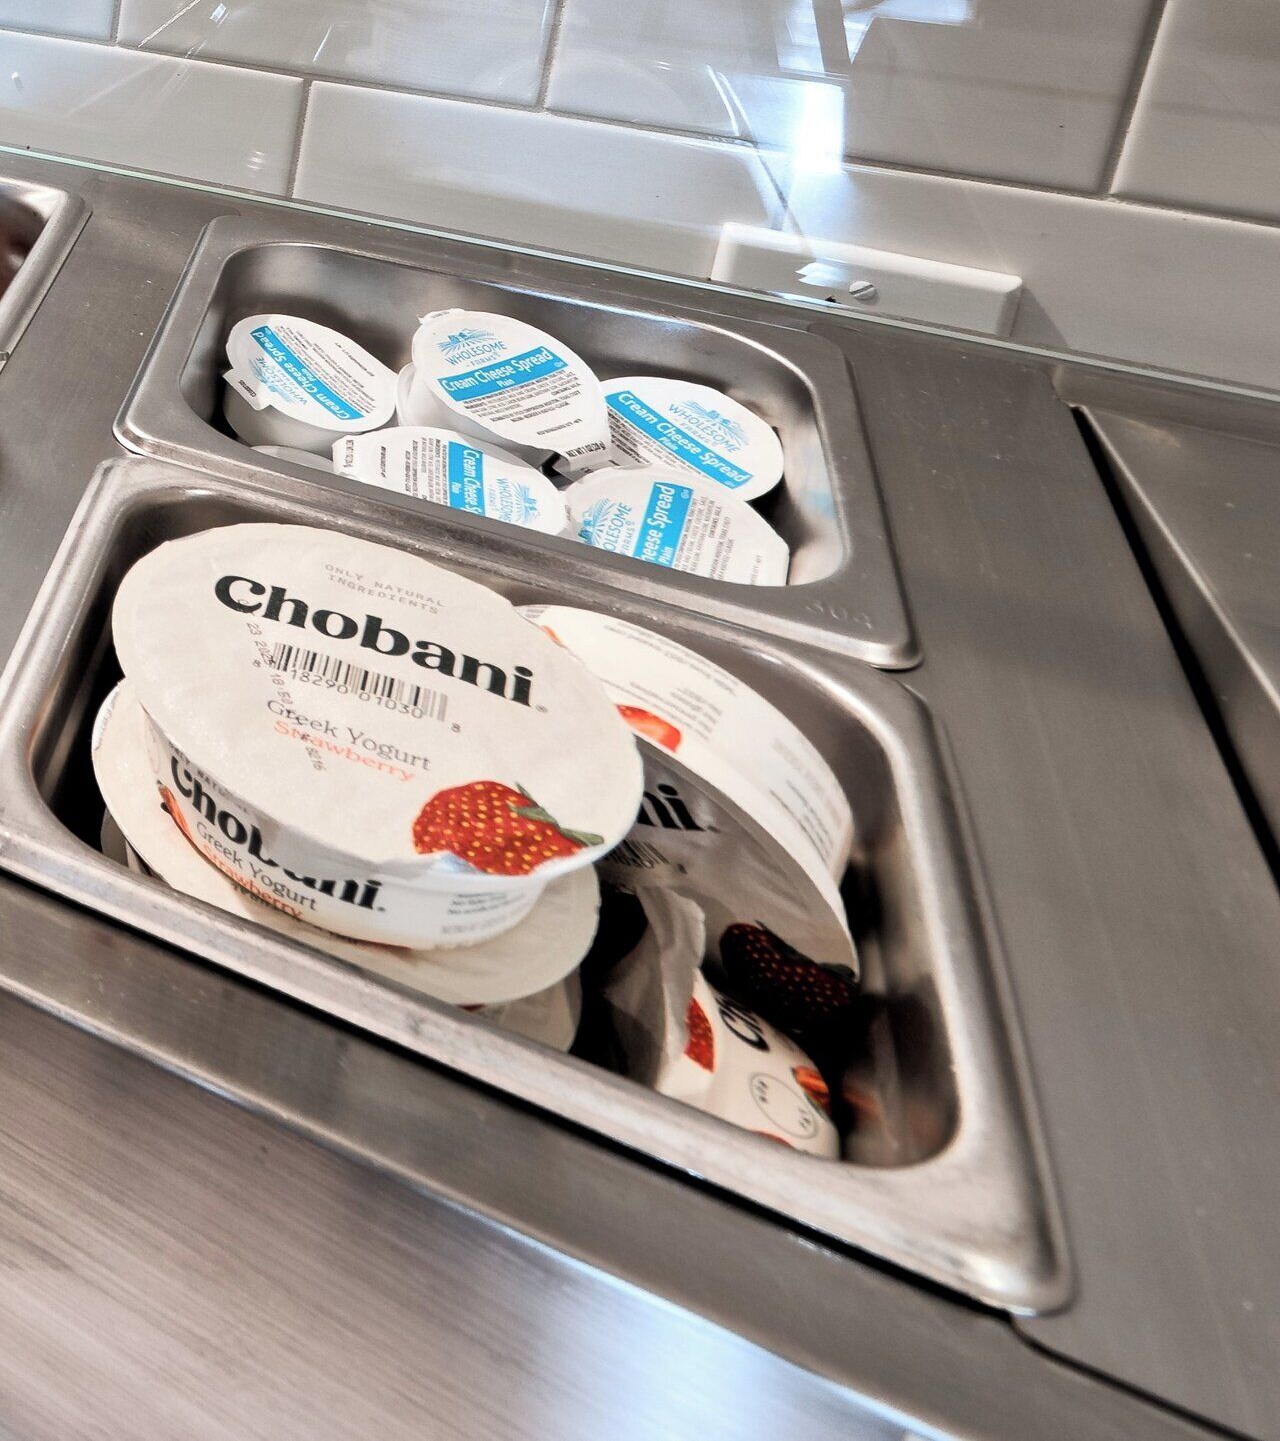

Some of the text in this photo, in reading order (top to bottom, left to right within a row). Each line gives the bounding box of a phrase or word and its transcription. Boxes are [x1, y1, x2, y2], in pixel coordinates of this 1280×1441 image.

[252, 331, 286, 363] Spread
[445, 340, 508, 367] WHOLESOME
[284, 362, 317, 395] Cheese
[441, 350, 554, 392] Cream Cheese Spread
[497, 378, 515, 389] Plain
[316, 393, 350, 419] Cream
[618, 393, 657, 424] Cream
[656, 422, 702, 455] Cheese
[699, 452, 751, 482] Spread
[658, 436, 680, 452] Plain
[669, 404, 741, 453] WHOLESOME
[462, 449, 481, 478] Cream
[464, 478, 482, 504] Cheese
[603, 502, 632, 552] OLESOME
[641, 483, 675, 562] eese Spread
[657, 546, 673, 565] Plain
[324, 563, 446, 608] ONLY NATURAL
[328, 574, 439, 615] INGREDIENTS
[291, 668, 348, 695] 18290
[359, 692, 424, 720] 01030
[267, 699, 337, 738] Greek
[346, 727, 431, 772] Yogurt
[273, 719, 416, 783] Strawberry
[196, 821, 318, 910] Greek Yogurt
